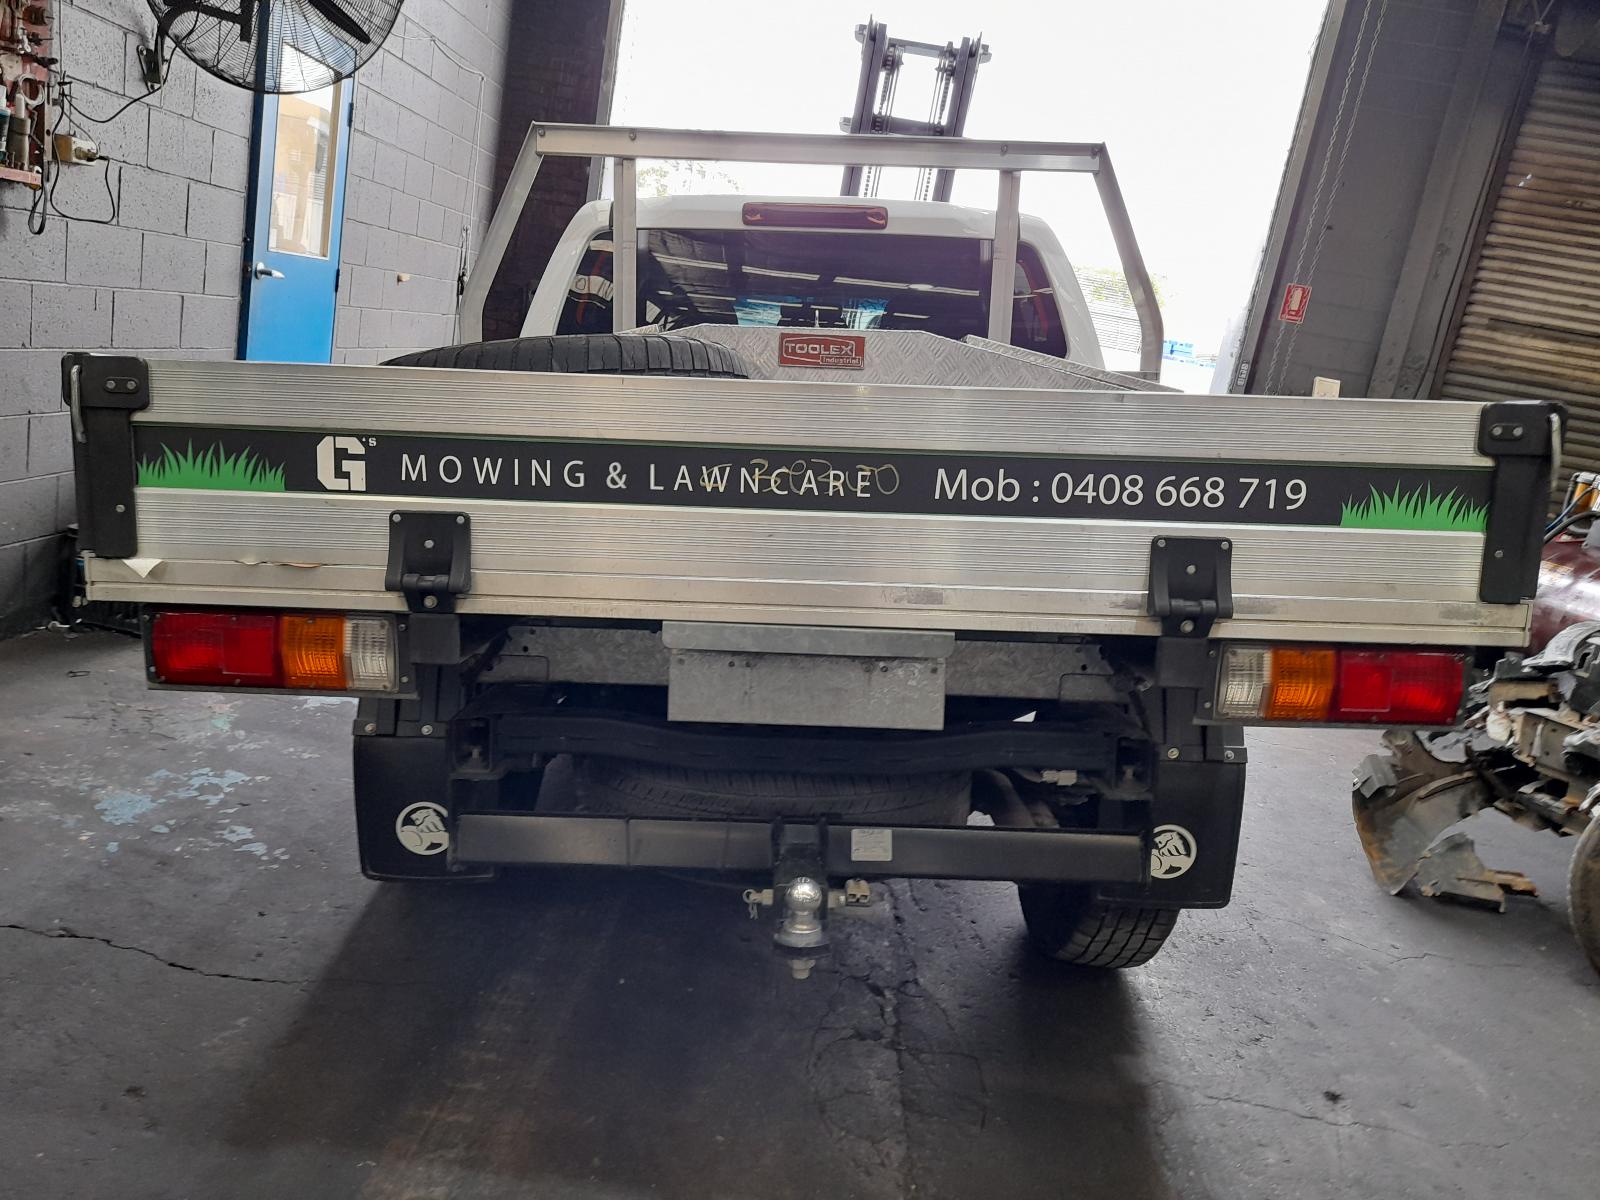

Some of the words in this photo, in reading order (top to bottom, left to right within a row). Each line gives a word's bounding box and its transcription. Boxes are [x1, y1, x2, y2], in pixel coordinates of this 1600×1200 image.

[785, 342, 853, 355] TOOLEX
[401, 453, 585, 488] MOWING
[606, 462, 628, 490] &
[650, 463, 872, 498] LAWNCARE
[1051, 472, 1145, 506] 0408
[1155, 475, 1226, 508] 668
[1238, 477, 1308, 511] 719
